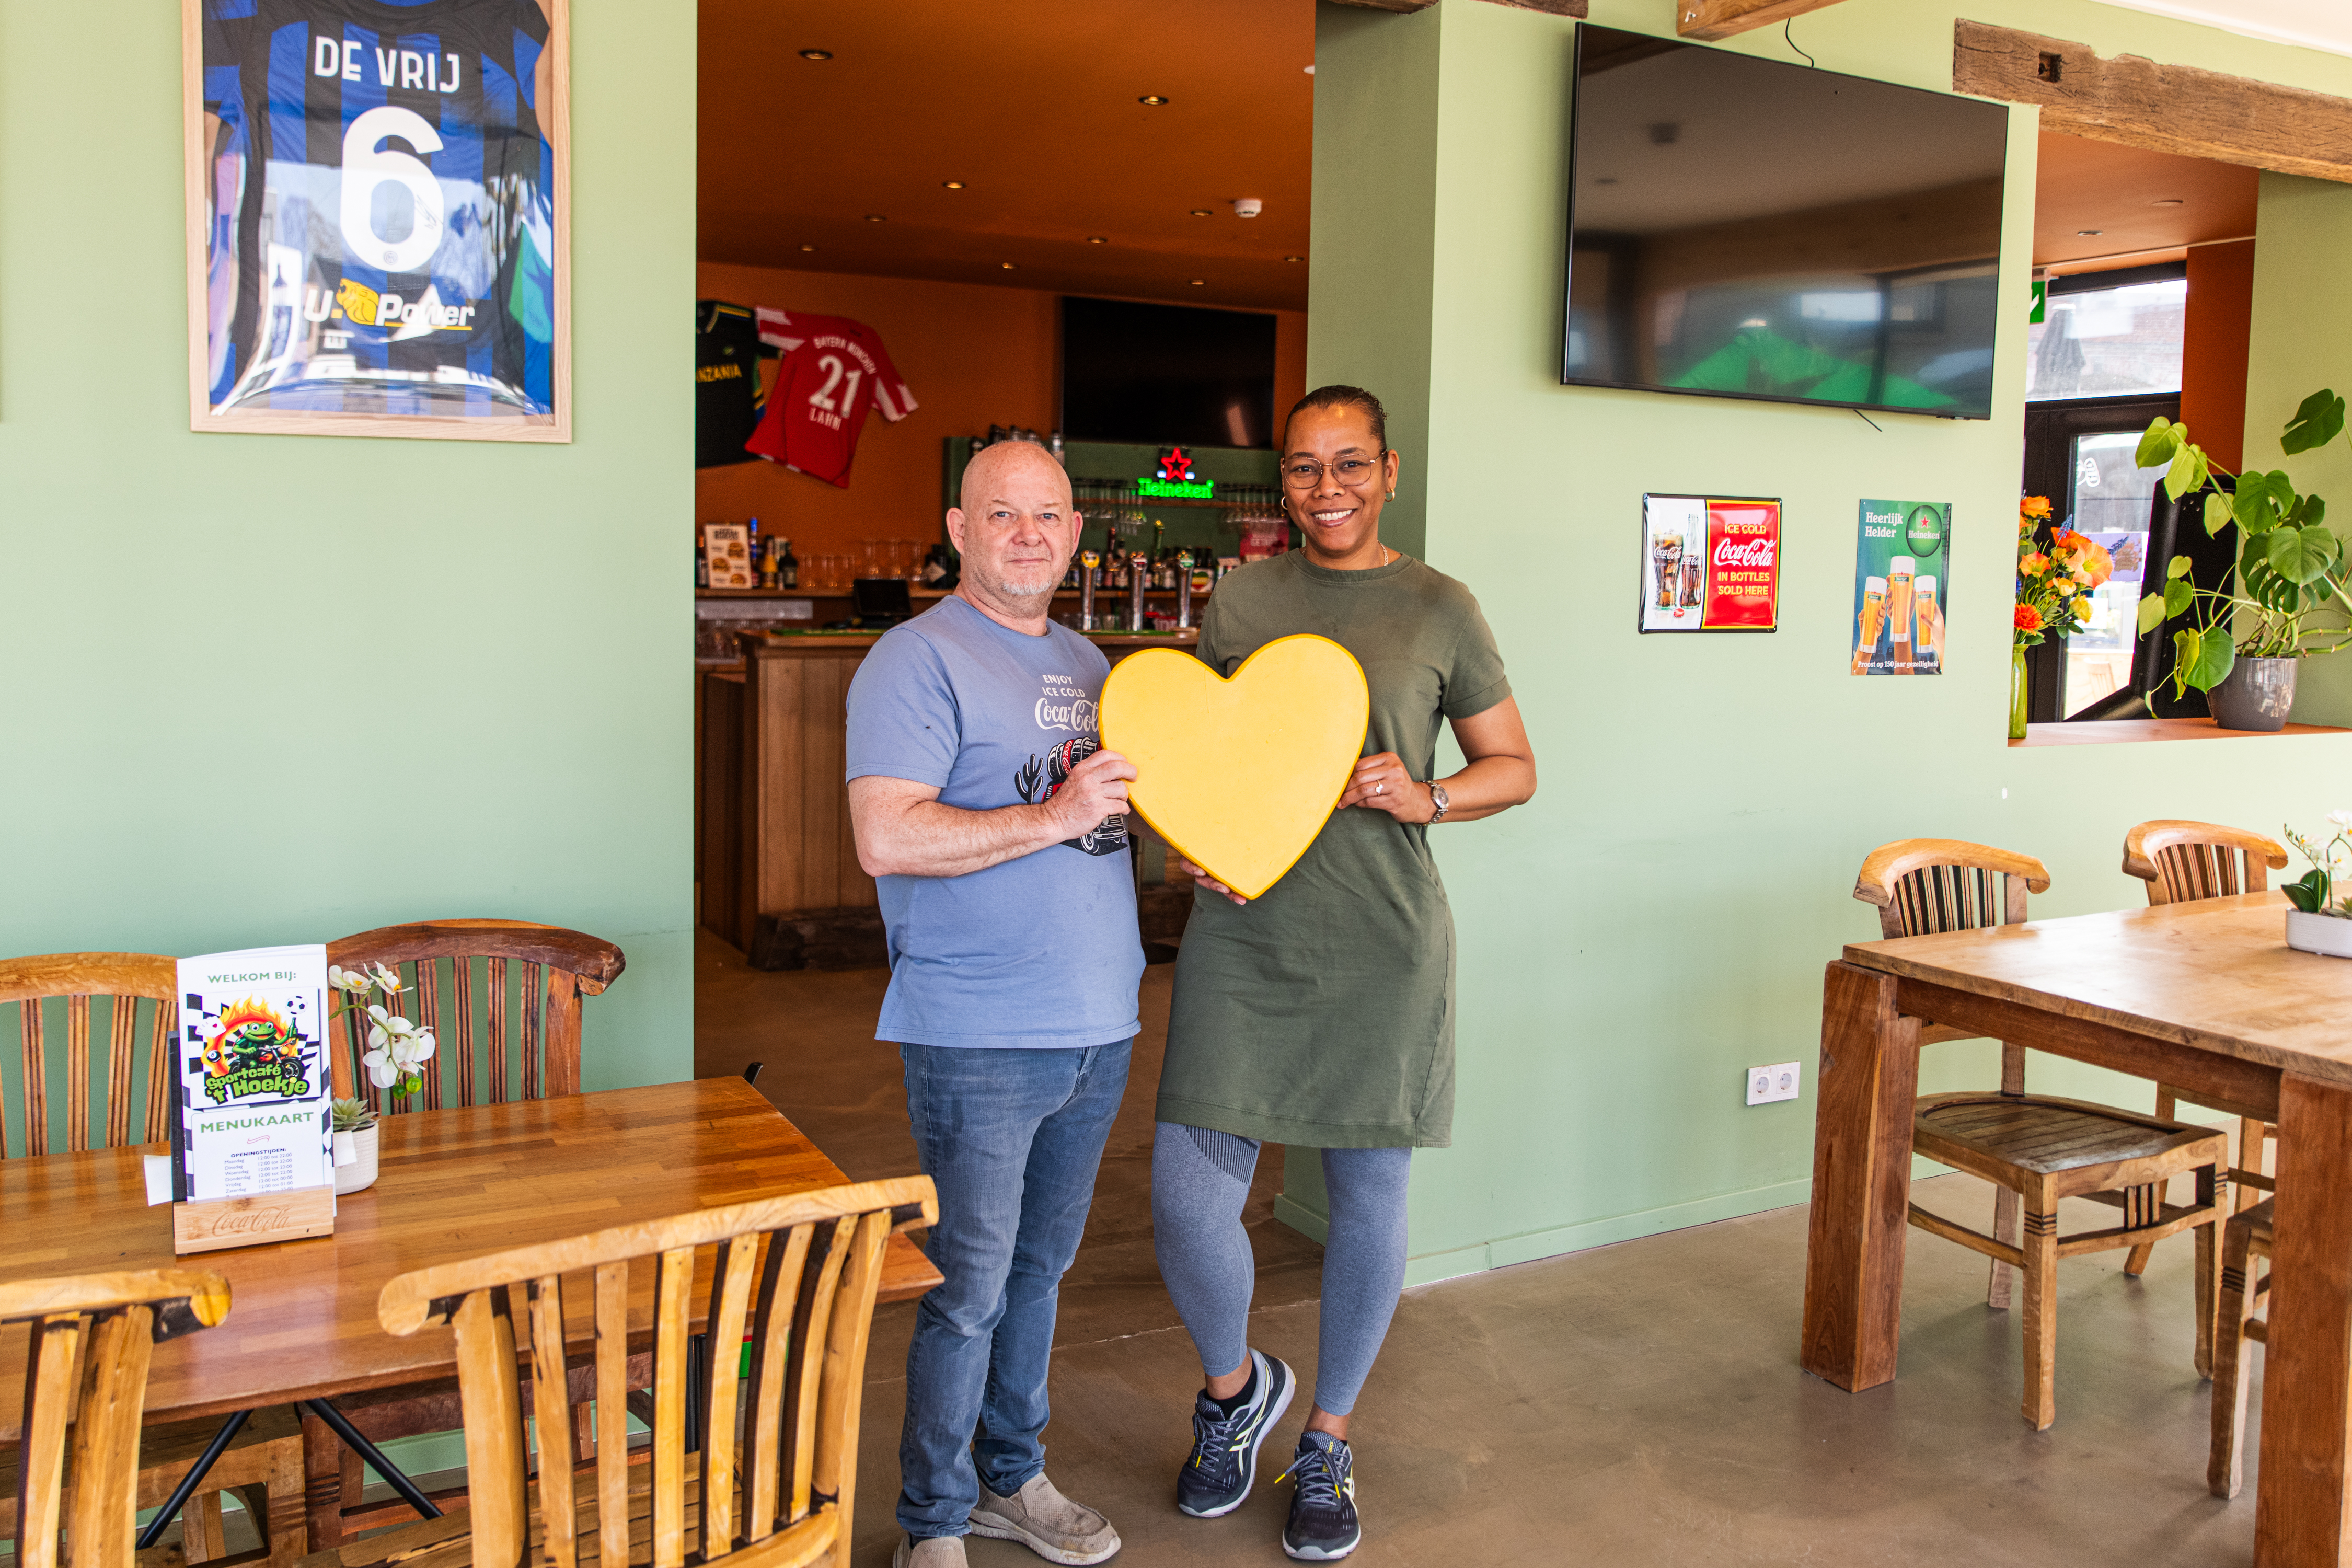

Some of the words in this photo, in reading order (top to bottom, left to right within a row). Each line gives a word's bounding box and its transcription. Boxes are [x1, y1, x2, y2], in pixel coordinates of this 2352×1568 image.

[315, 35, 362, 82] DE
[376, 47, 460, 93] VRIJ
[340, 106, 444, 272] 6
[375, 294, 475, 326] Power
[696, 363, 742, 383] NZANIA
[809, 354, 862, 419] 21
[809, 407, 842, 431] LAHM
[1137, 478, 1213, 498] Heineken
[1725, 524, 1739, 534] ICE
[1742, 524, 1767, 534] COLD
[1866, 512, 1903, 526] Heerlijk
[1865, 526, 1897, 537] Helder
[1908, 530, 1940, 539] Heineken
[1654, 546, 1682, 559] Coca-Cola
[1714, 538, 1777, 566] Coca-Cola
[1718, 572, 1728, 581] IN
[1730, 572, 1770, 582] BOTTLES
[1718, 586, 1743, 595] SOLD
[1745, 586, 1768, 595] HERE
[1043, 674, 1073, 685] ENJOY
[1042, 687, 1059, 696] ICE
[1060, 688, 1086, 697] COLD
[1035, 697, 1099, 732] Coca-Col
[207, 972, 270, 983] WELKOM
[275, 971, 296, 981] BIJ:
[206, 1064, 281, 1090] Sportcafé
[233, 1075, 308, 1097] Hoekje
[201, 1112, 314, 1133] MENUKAART
[230, 1148, 286, 1158] OPENINGSTIJDEN:
[212, 1204, 294, 1237] Coca-Cola
